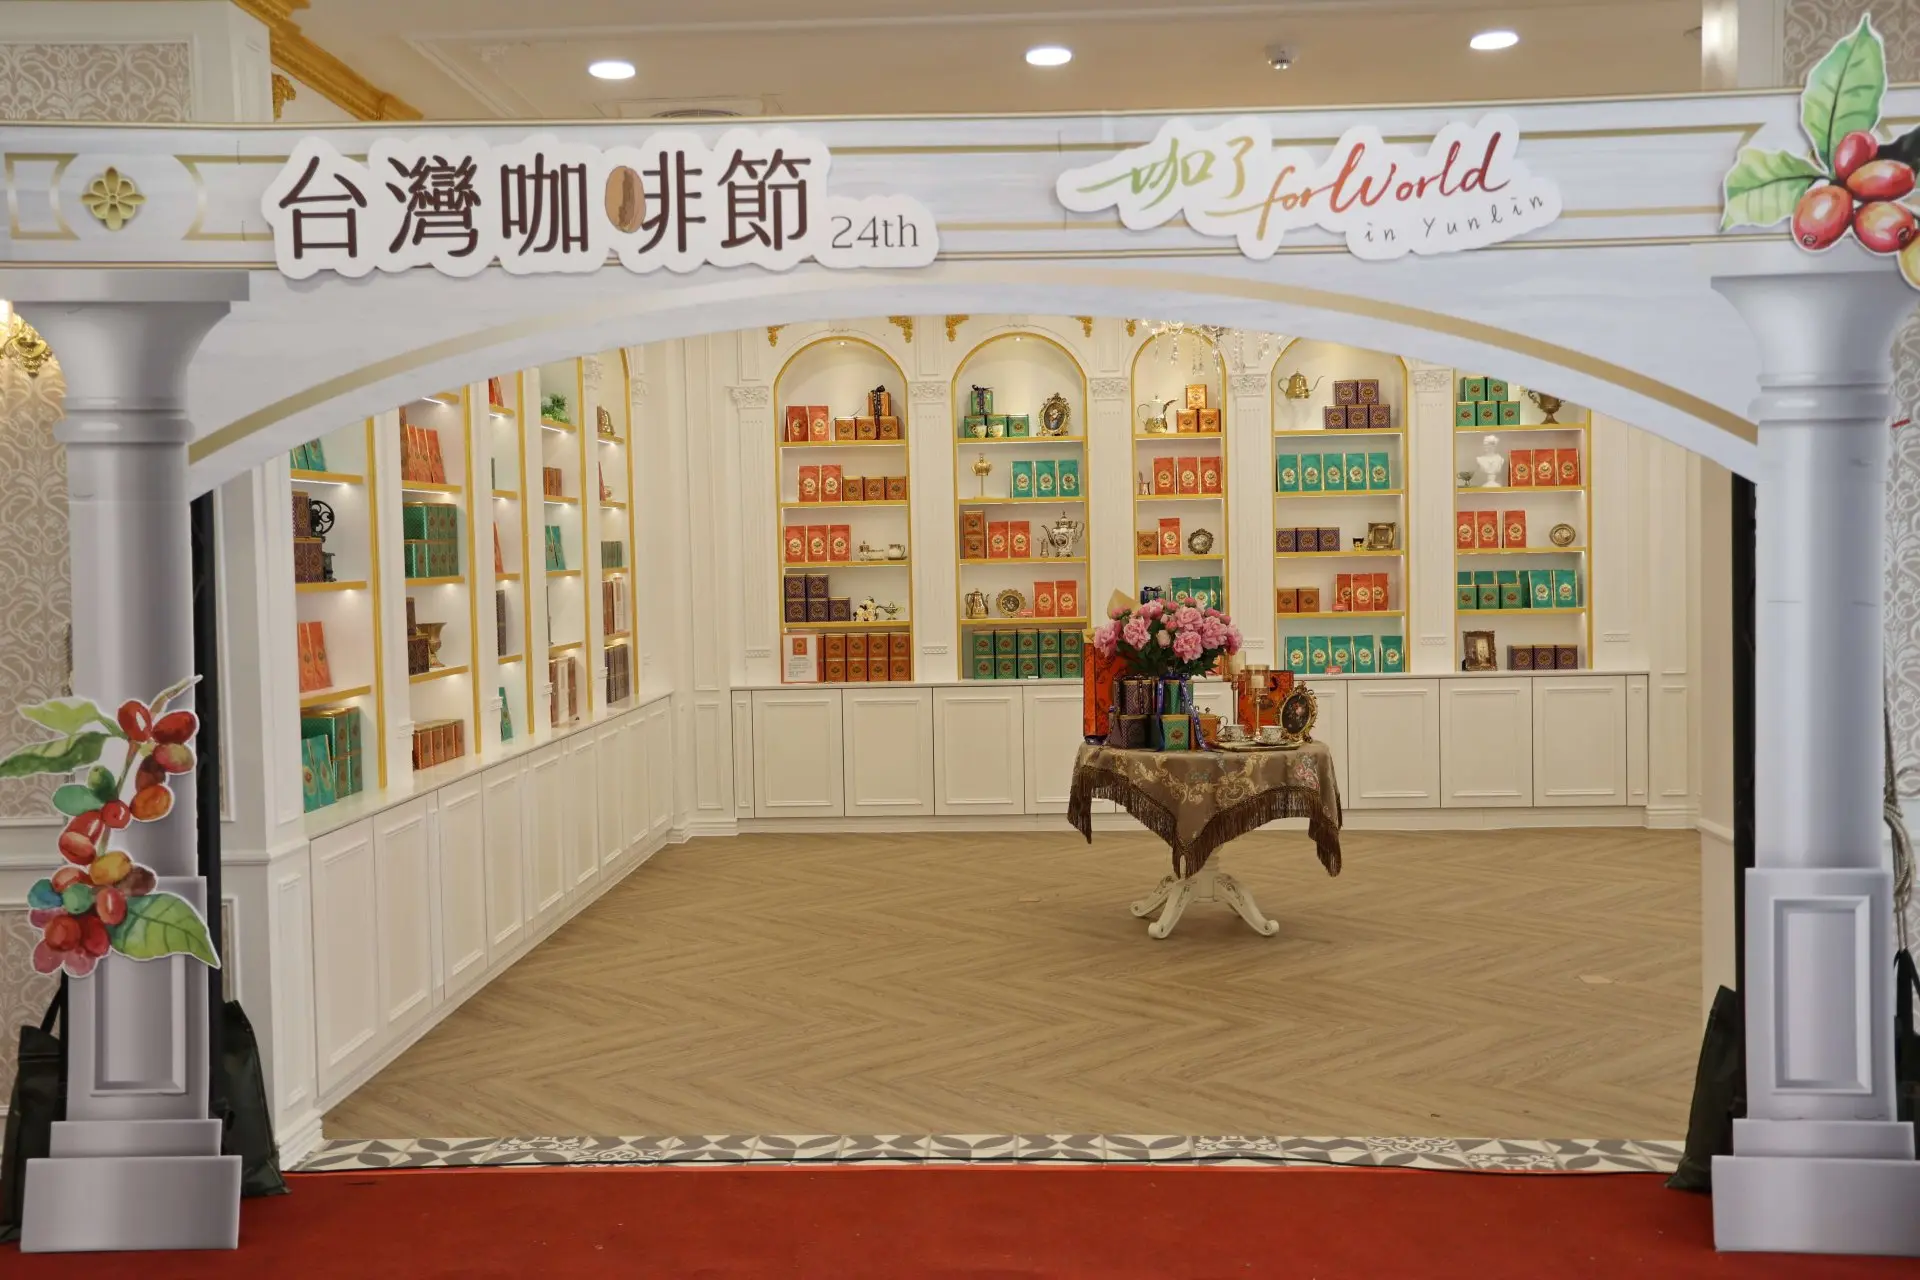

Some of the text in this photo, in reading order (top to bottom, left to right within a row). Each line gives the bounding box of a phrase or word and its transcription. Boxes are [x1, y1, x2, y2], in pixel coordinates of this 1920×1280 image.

[278, 148, 813, 260] 台灣咖啡節
[1364, 194, 1544, 243] in Yunlin
[829, 214, 921, 250] 24th
